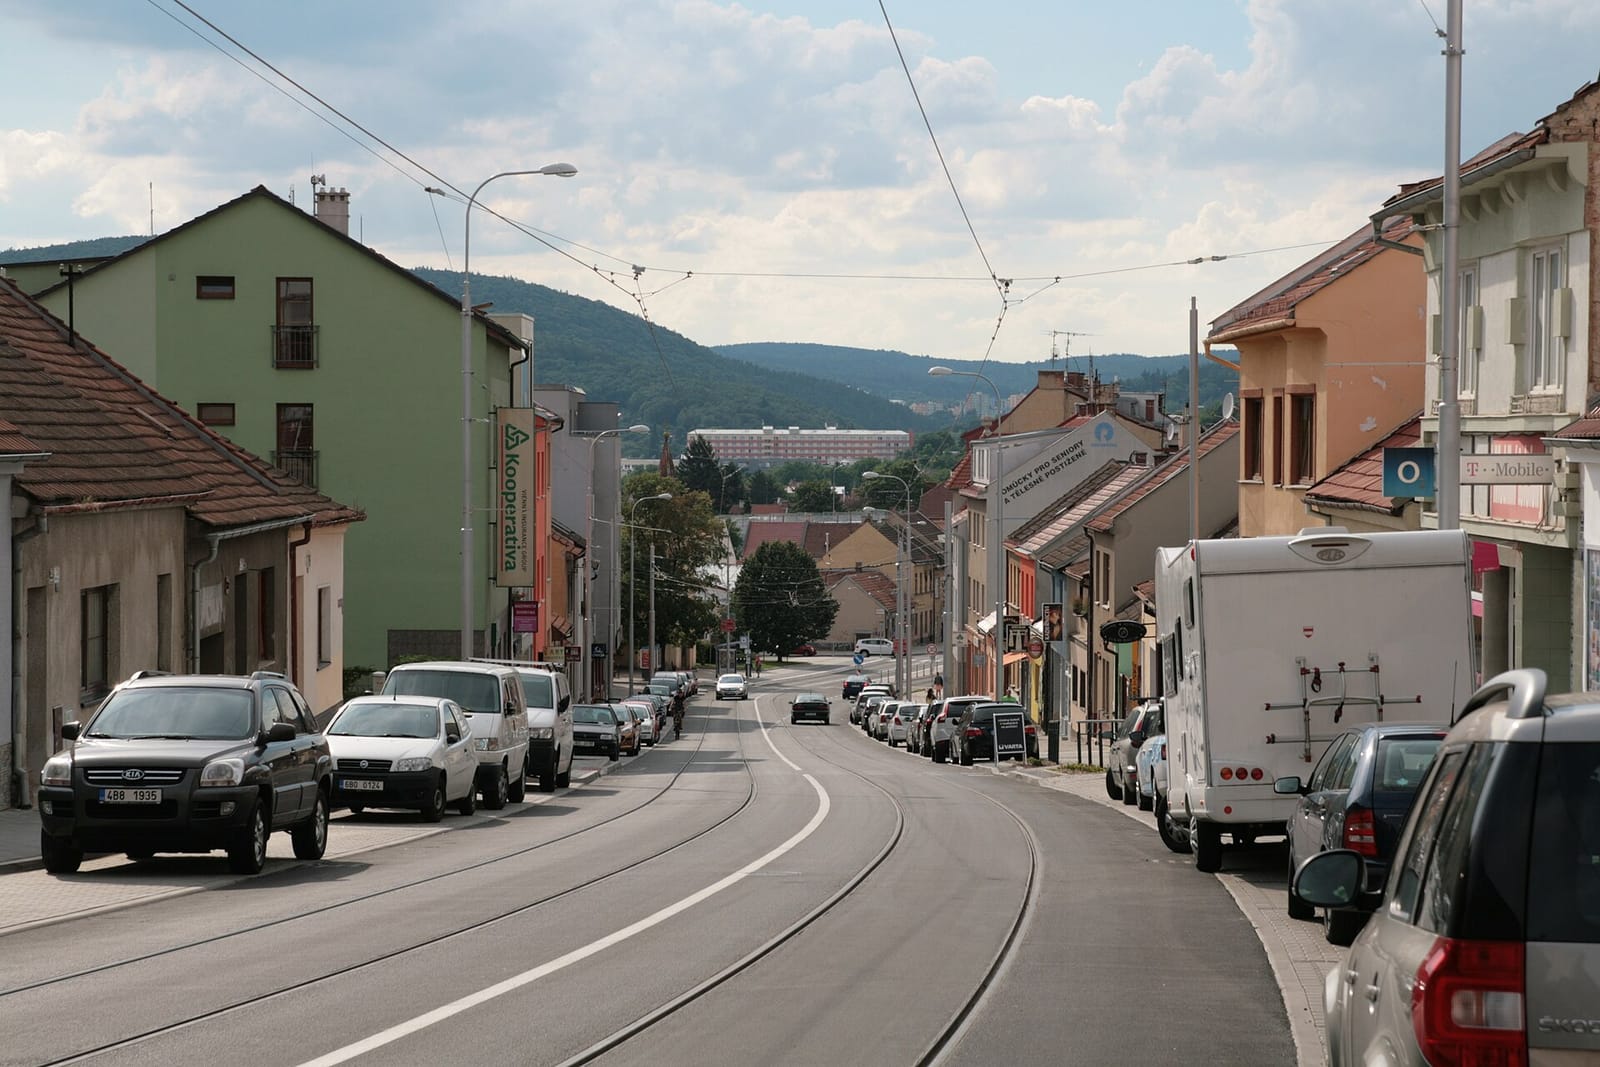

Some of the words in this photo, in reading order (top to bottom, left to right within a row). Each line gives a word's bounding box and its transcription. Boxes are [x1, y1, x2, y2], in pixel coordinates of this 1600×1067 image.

[1000, 471, 1033, 495] OMŮCKY
[1034, 461, 1050, 474] PRO
[1051, 440, 1084, 464] SENIORY
[501, 454, 519, 572] Kooperativa
[133, 791, 157, 800] 1935
